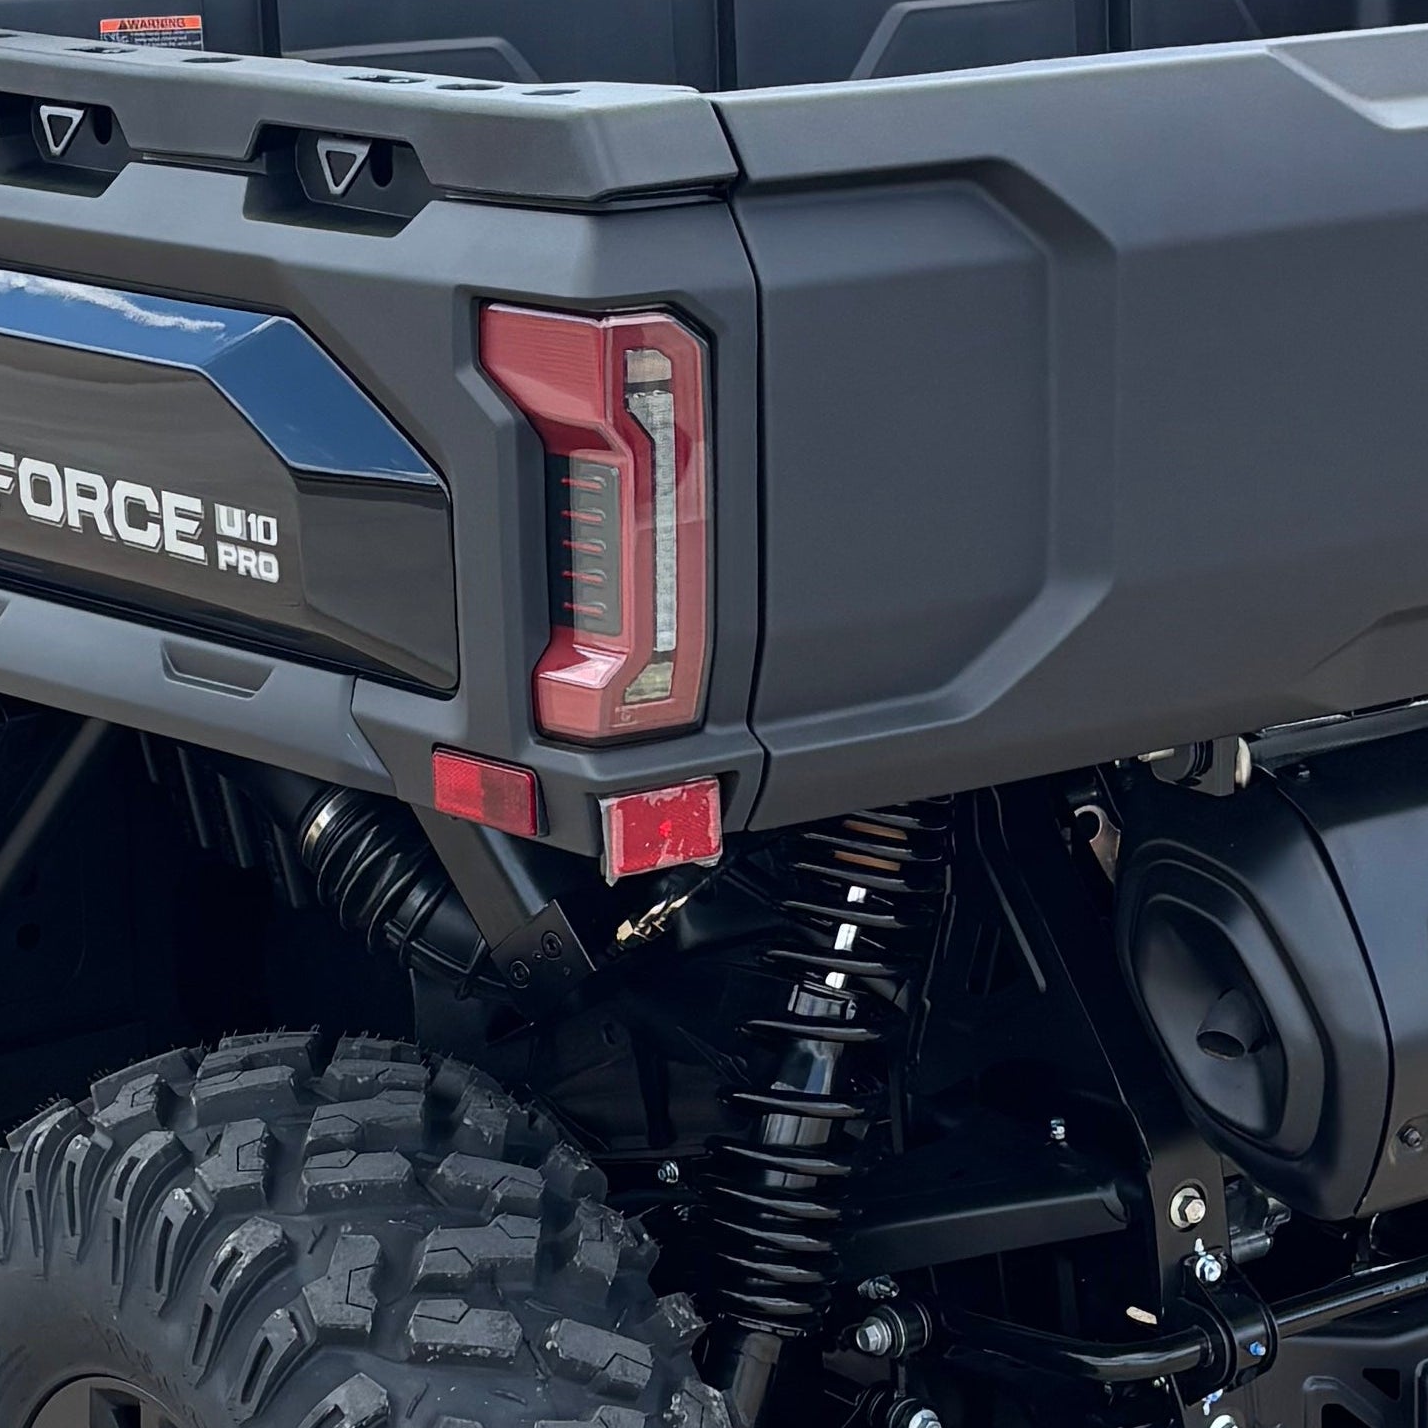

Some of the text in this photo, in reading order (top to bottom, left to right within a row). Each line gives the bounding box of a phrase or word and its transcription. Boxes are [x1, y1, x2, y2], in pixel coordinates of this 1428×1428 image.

[128, 17, 186, 29] WARNING
[215, 503, 278, 546] U10
[217, 540, 280, 583] PRO
